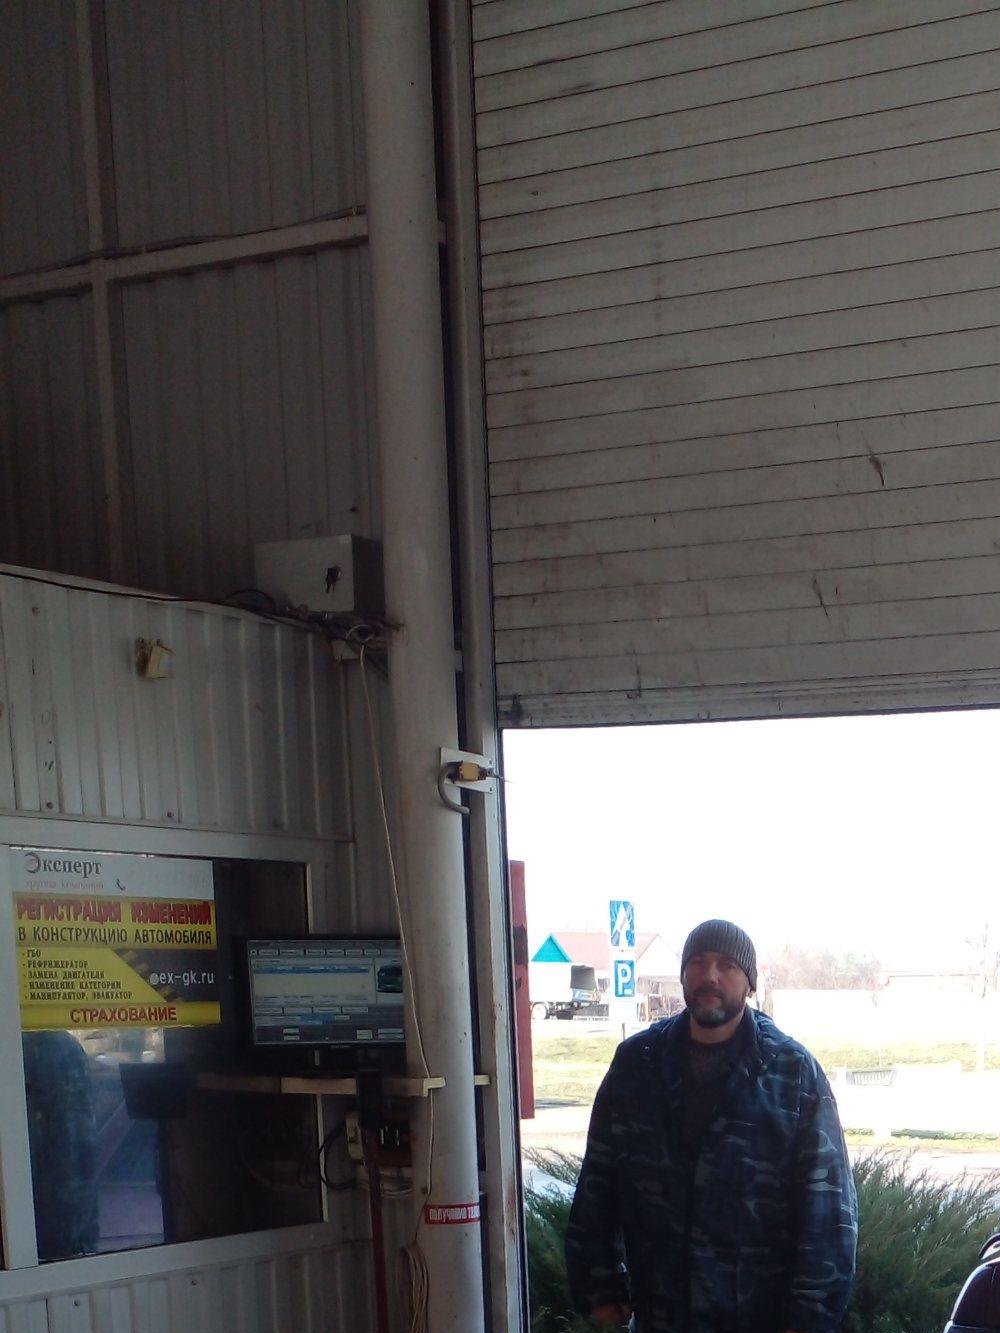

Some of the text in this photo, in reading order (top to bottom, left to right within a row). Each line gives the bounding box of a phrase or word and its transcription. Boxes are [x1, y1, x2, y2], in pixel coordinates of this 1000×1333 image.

[24, 851, 102, 879] Эксперт
[16, 898, 212, 926] РЕГИСТРАЦИЯ ИЗМЕНЕНИЙ
[18, 926, 212, 945] В КОНСТРУКЦИЮ АВТОМОБИЛЯ
[26, 950, 42, 958] ГБО
[27, 960, 89, 969] РЕФРИЖЕРАТОР
[28, 970, 105, 979] ЗАМЕНА ДВИГАТЕЛЯ
[159, 970, 215, 986] ex-gk.ru
[70, 1007, 177, 1023] СТРАХОВАНИЕ
